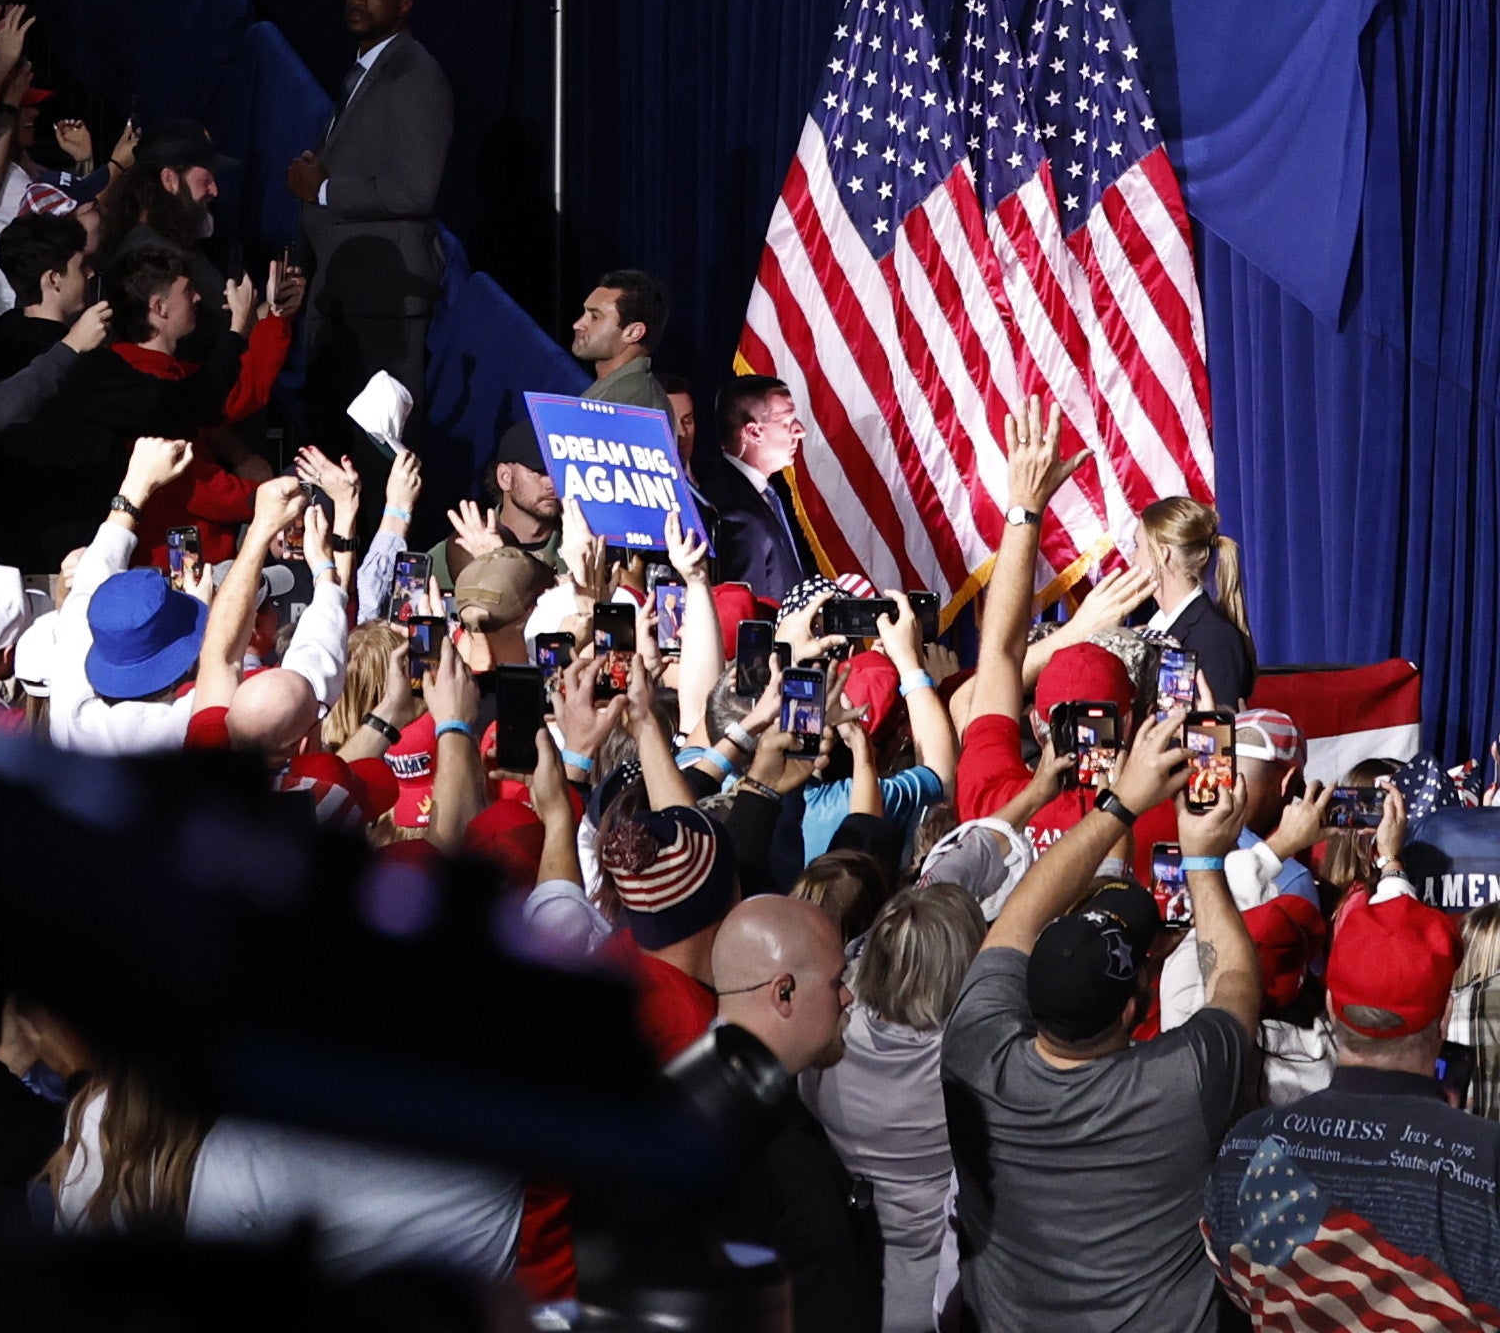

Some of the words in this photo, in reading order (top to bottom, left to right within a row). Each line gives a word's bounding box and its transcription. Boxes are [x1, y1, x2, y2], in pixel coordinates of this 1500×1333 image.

[548, 434, 629, 467] DREAM
[630, 444, 679, 479] BIG,
[564, 463, 682, 513] AGAIN!
[626, 531, 652, 546] 2024
[1282, 1113, 1388, 1142] CONGRESS.
[1442, 1162, 1497, 1195] Americ
